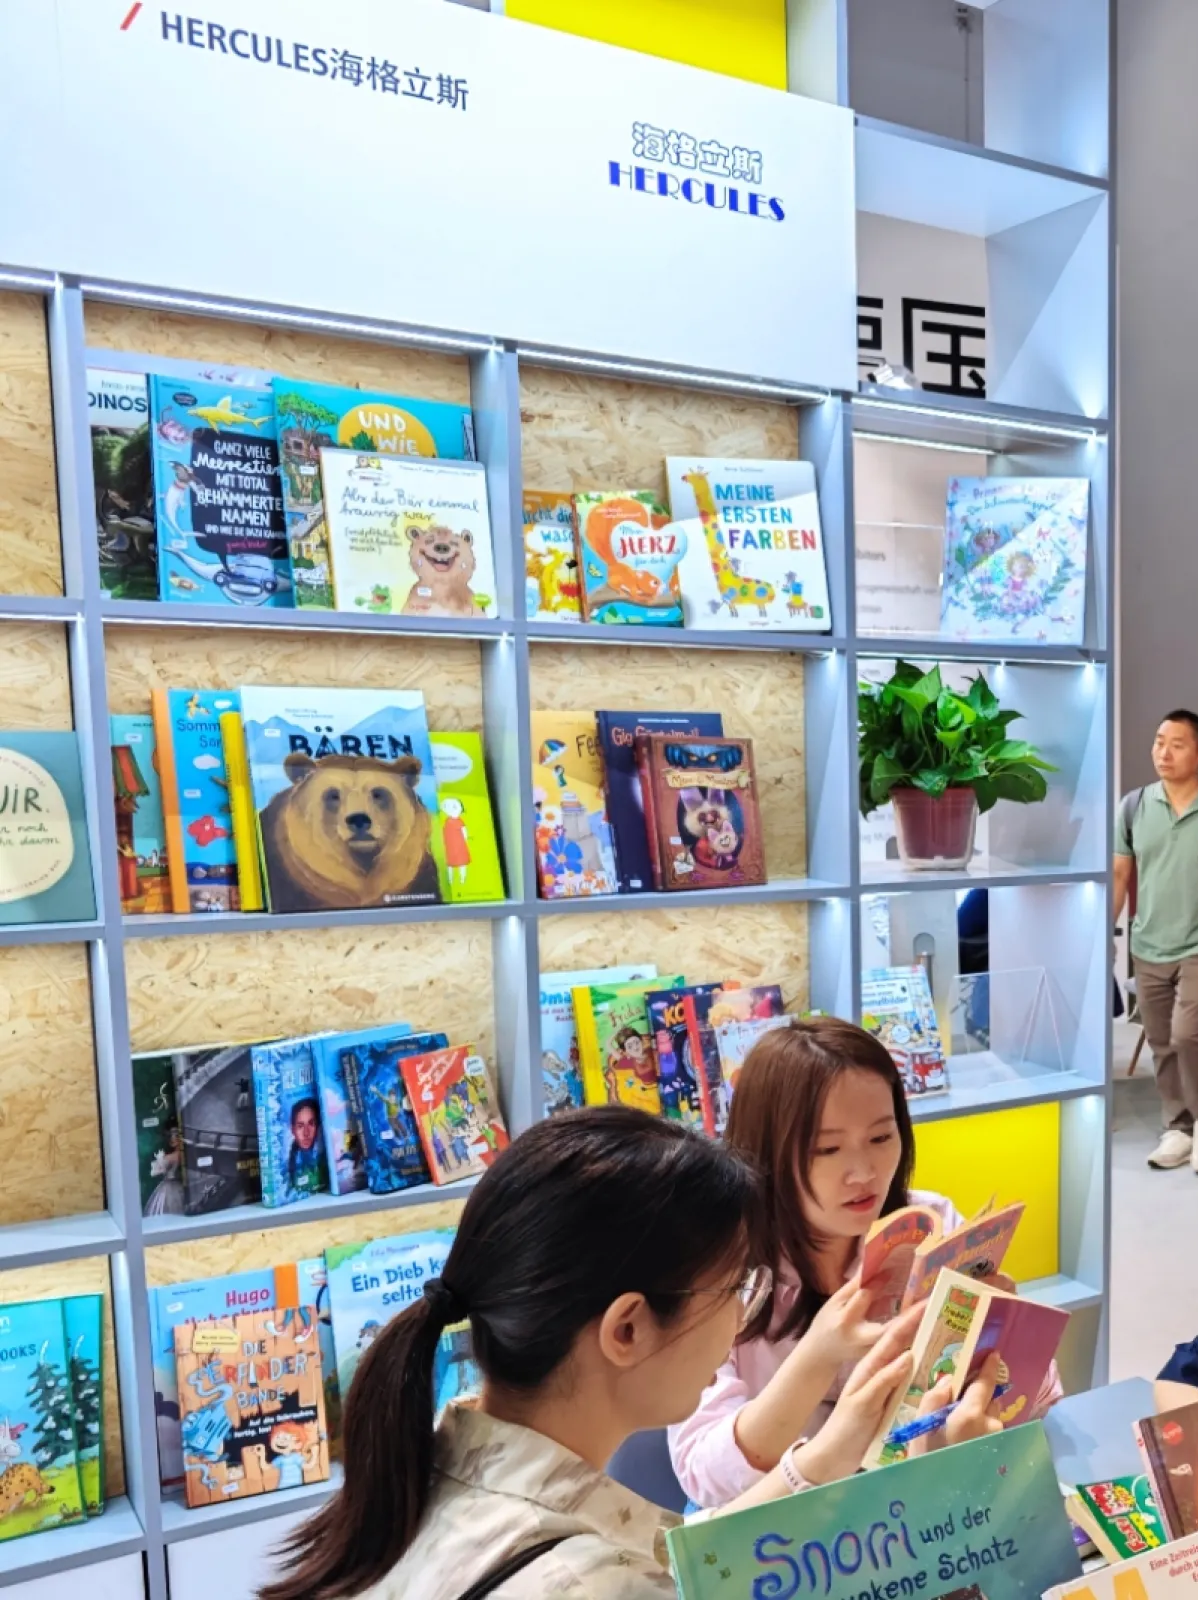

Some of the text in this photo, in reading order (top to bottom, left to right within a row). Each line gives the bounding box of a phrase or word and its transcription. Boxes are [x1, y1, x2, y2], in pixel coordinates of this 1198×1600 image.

[632, 121, 763, 184] 海格立斯
[608, 160, 786, 222] HERCULES
[358, 410, 406, 432] UND
[214, 440, 272, 459] GANZ VIELE
[216, 472, 270, 491] MIT TOTAL
[715, 484, 776, 501] MEINE
[221, 508, 270, 527] NAMEN
[722, 506, 793, 524] ERSTEN
[617, 535, 680, 558] HERZ
[728, 529, 817, 550] FARBEN
[289, 726, 415, 760] BÄREN
[352, 1274, 380, 1293] Ein
[384, 1260, 424, 1285] Dieb
[226, 1288, 270, 1308] Hugo
[243, 1340, 267, 1357] DIE
[237, 1386, 287, 1409] BANDE
[753, 1500, 991, 1600] Snorri und der
[938, 1536, 1020, 1582] Schatz
[1149, 1558, 1169, 1571] Eine
[1169, 1560, 1193, 1577] durch
